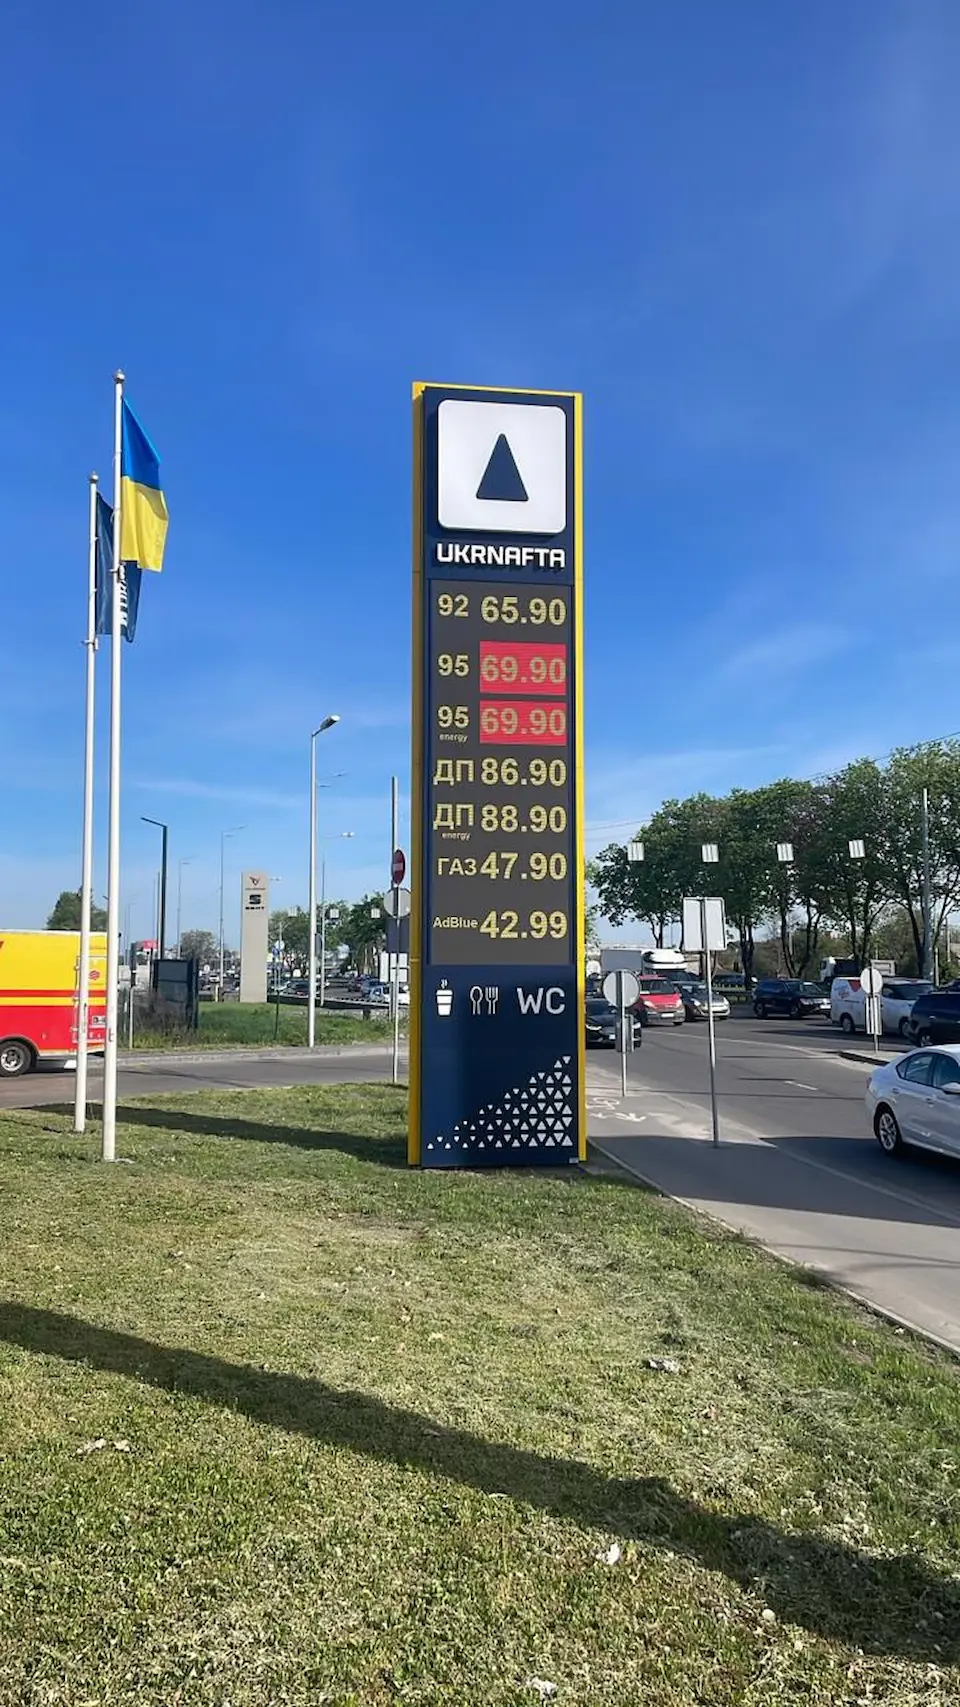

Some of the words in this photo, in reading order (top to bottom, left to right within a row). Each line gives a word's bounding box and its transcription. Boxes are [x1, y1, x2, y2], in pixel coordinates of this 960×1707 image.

[437, 543, 566, 568] UKRNAFTA
[438, 594, 469, 617] 92
[481, 596, 567, 625] 65.90
[438, 654, 469, 676] 95
[481, 655, 567, 683] 69.90
[438, 706, 469, 728] 95
[481, 708, 567, 736] 69.90
[439, 733, 468, 743] energy
[433, 760, 475, 786] ДП
[481, 758, 567, 787] 86.90
[433, 804, 475, 830] ДП
[481, 804, 567, 833] 88.90
[441, 832, 471, 841] energy
[437, 858, 477, 876] ГАЗ
[480, 851, 567, 880] 47.90
[433, 917, 479, 928] AdBlue
[479, 910, 568, 939] 42.99
[516, 987, 566, 1015] WC
